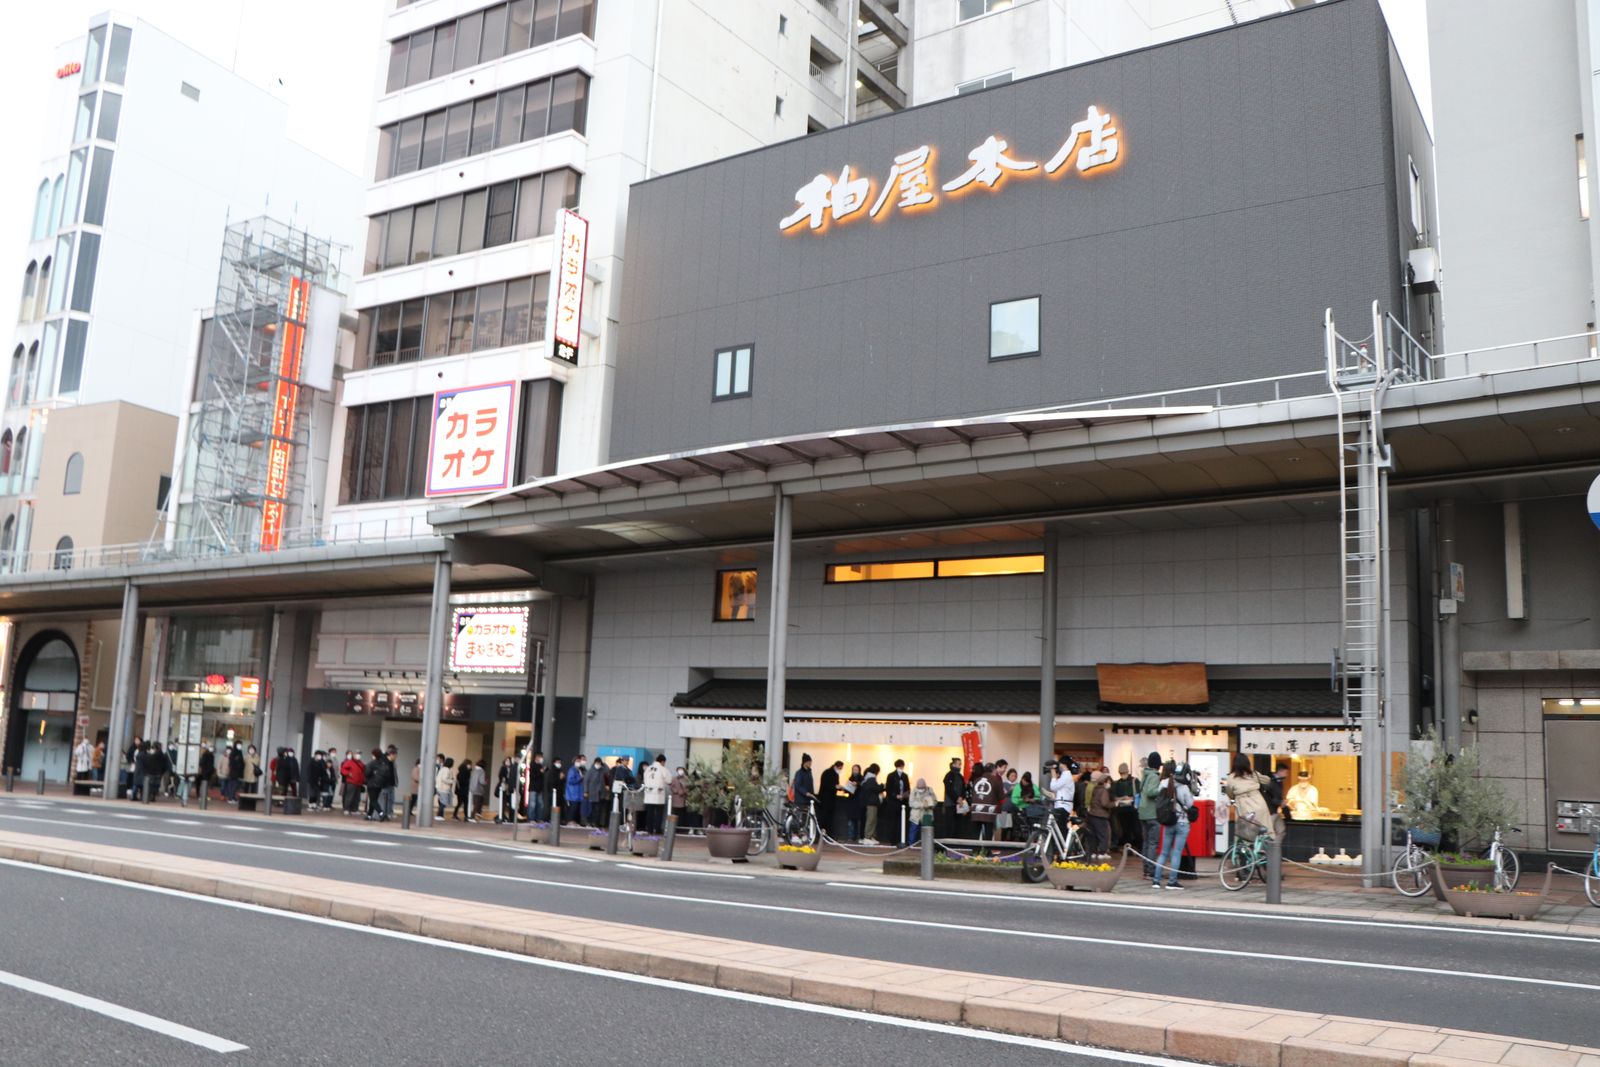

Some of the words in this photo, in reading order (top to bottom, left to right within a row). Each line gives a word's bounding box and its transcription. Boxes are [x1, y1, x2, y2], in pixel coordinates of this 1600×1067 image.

[778, 103, 1120, 231] 柏屋本店
[474, 623, 510, 636] カラオケ
[465, 640, 515, 660] まねきねこ
